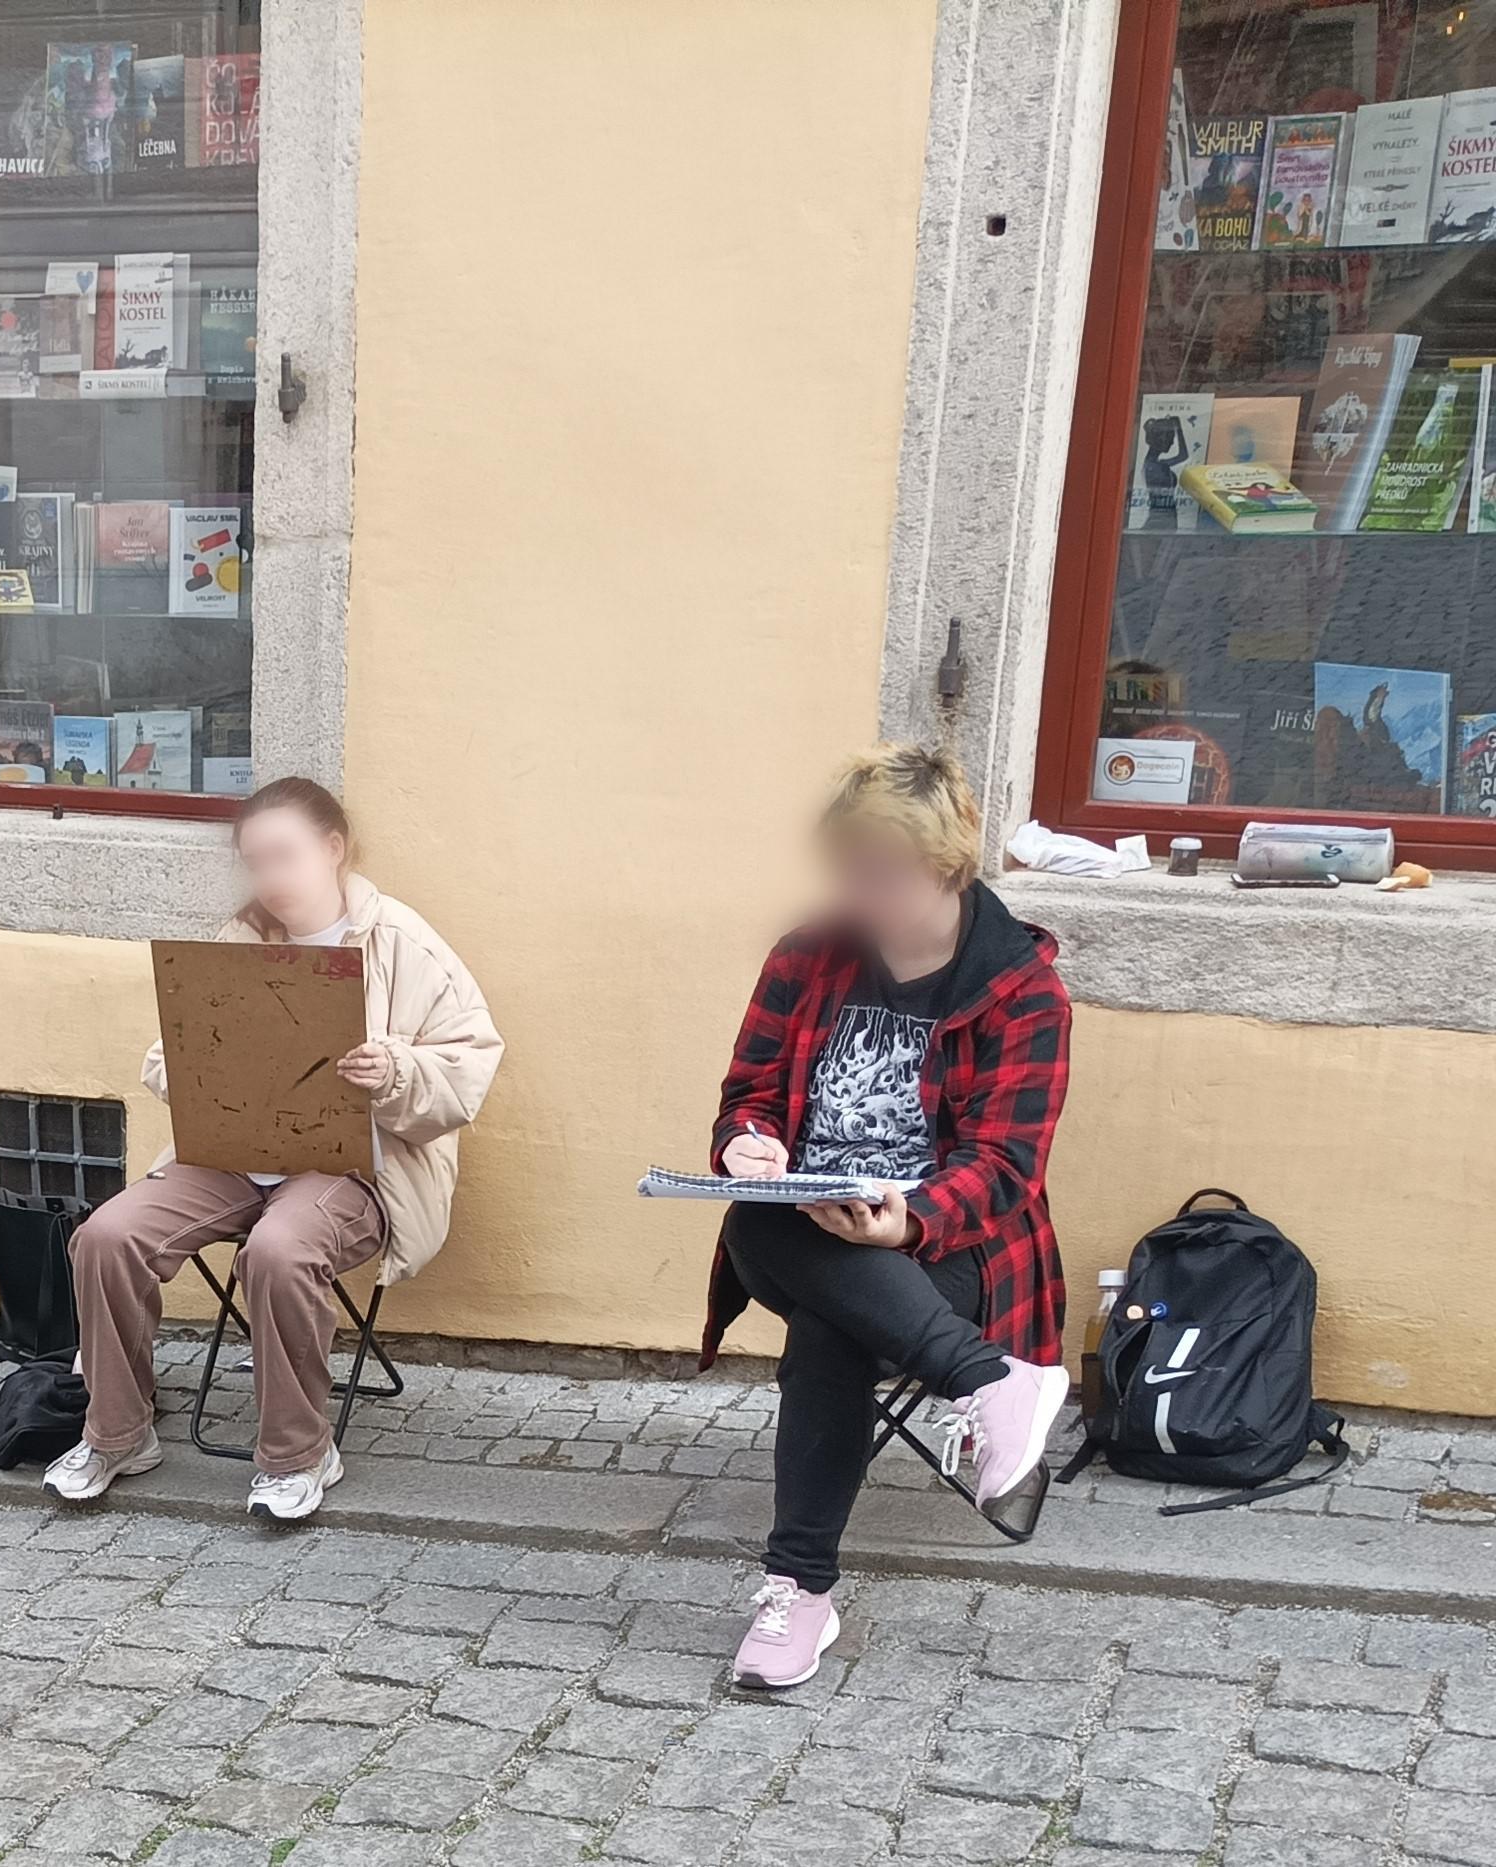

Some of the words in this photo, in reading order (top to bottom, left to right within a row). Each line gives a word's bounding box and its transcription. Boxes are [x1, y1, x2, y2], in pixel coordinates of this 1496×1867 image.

[1388, 108, 1412, 121] MALÉ
[1193, 121, 1264, 139] WILBUR
[139, 138, 176, 158] LÉČEBNA
[1195, 136, 1256, 156] SMITH
[122, 286, 164, 306] ŠIKMÝ
[118, 307, 167, 321] KOSTEL
[1270, 708, 1298, 731] Jiří
